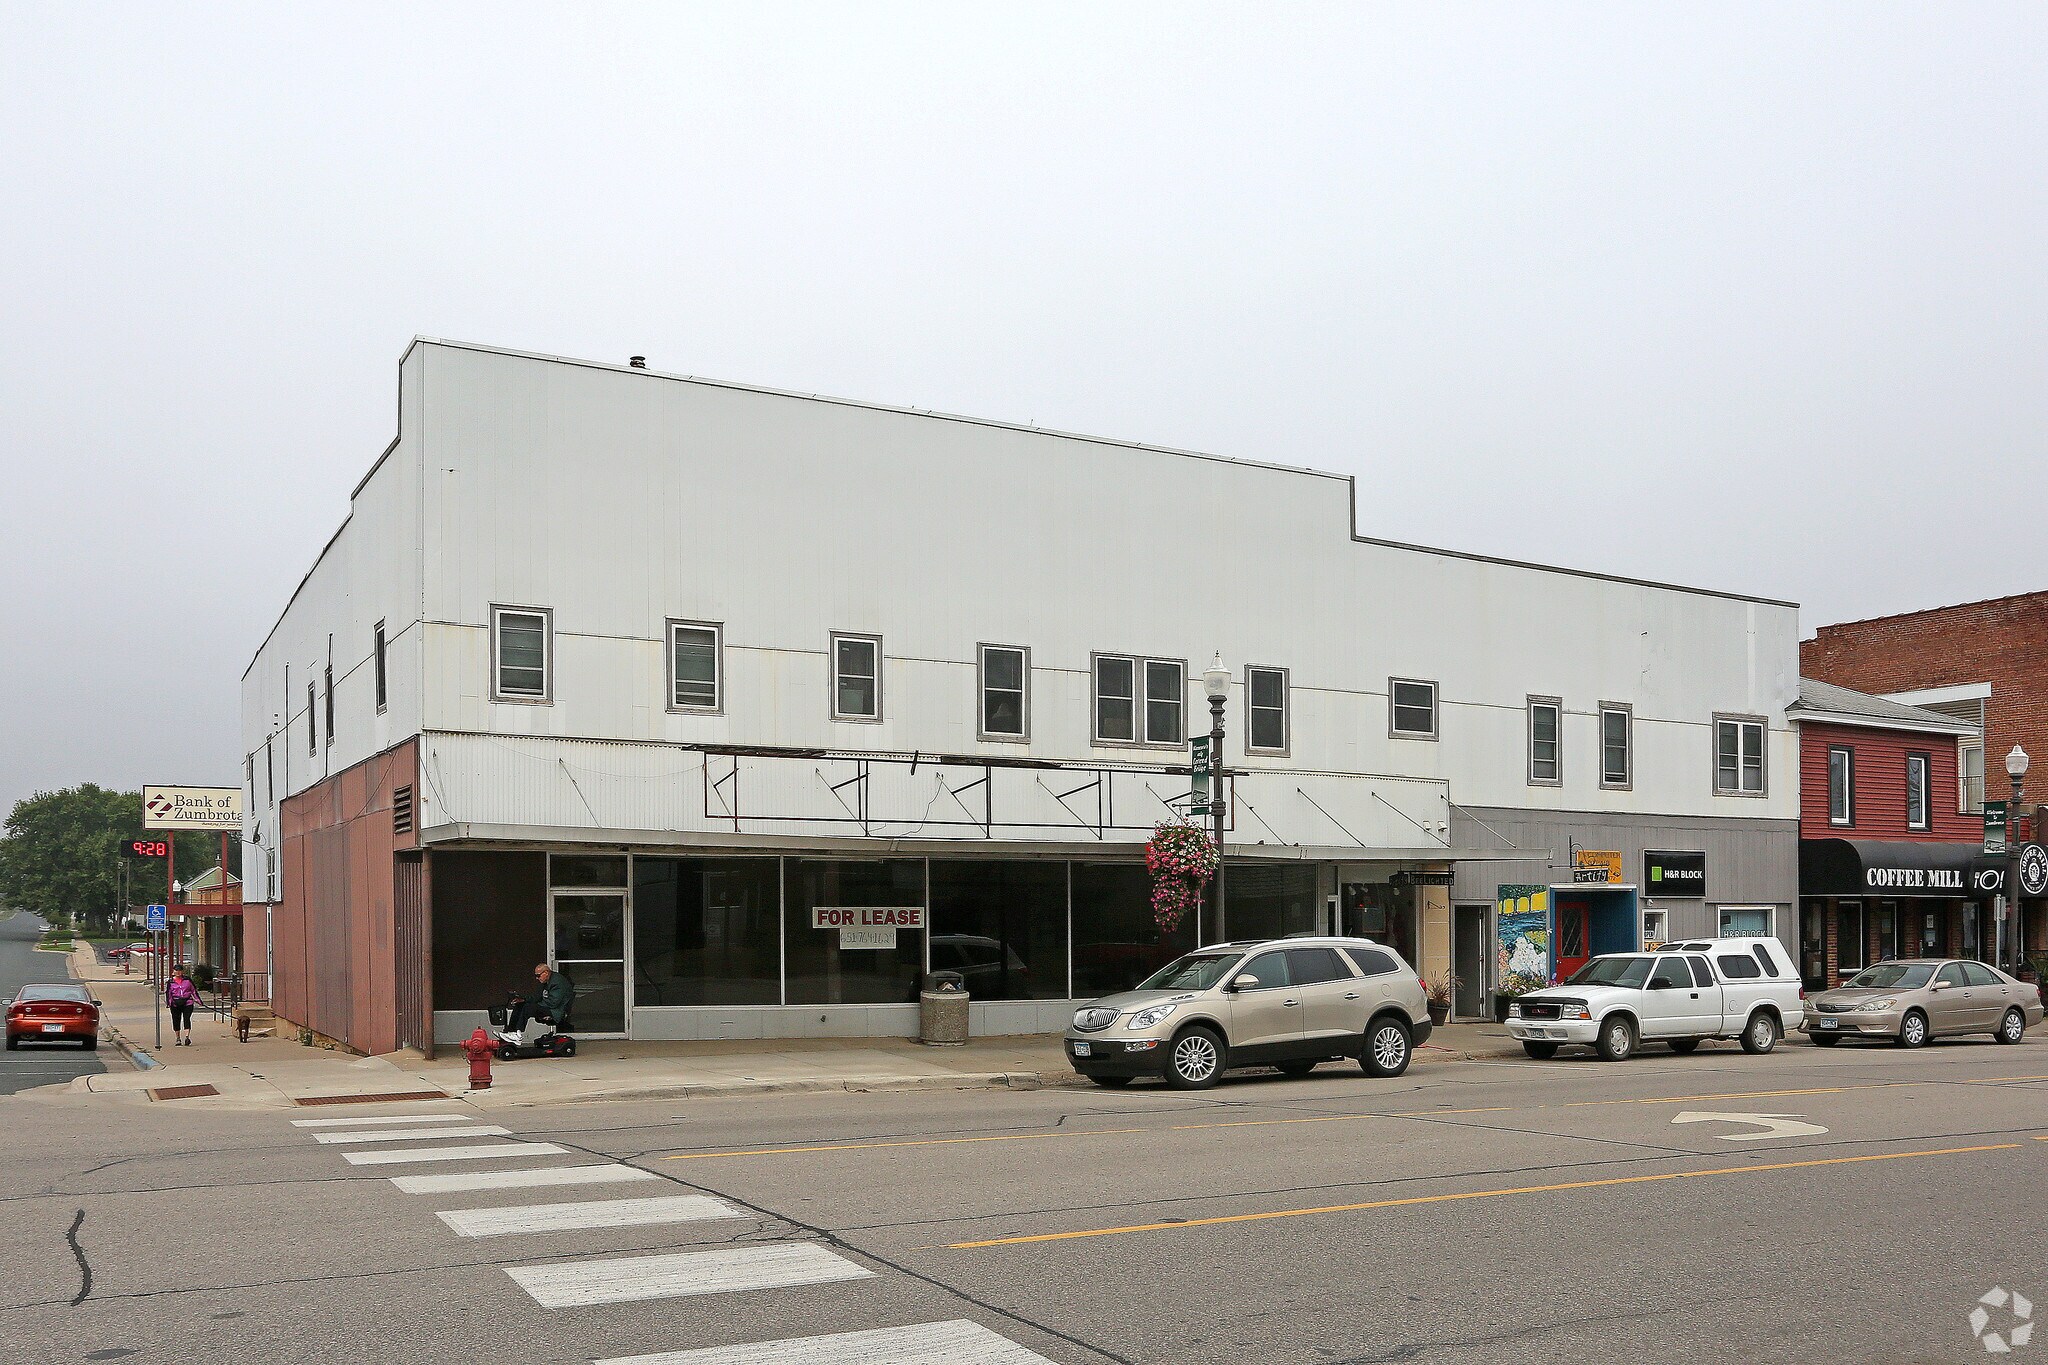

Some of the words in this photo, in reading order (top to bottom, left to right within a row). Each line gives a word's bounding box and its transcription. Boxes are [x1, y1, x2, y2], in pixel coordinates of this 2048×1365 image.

[174, 795, 213, 807] Bank
[217, 796, 232, 808] of
[133, 842, 166, 856] 9:28
[2021, 848, 2037, 874] COFFEE
[1575, 871, 1607, 882] Artify
[1664, 870, 1679, 879] H&R
[1680, 870, 1703, 879] BLOCK
[1866, 867, 1924, 887] COFFEE
[1927, 869, 1963, 888] MILL
[817, 910, 854, 925] FOR
[862, 910, 920, 925] LEASE
